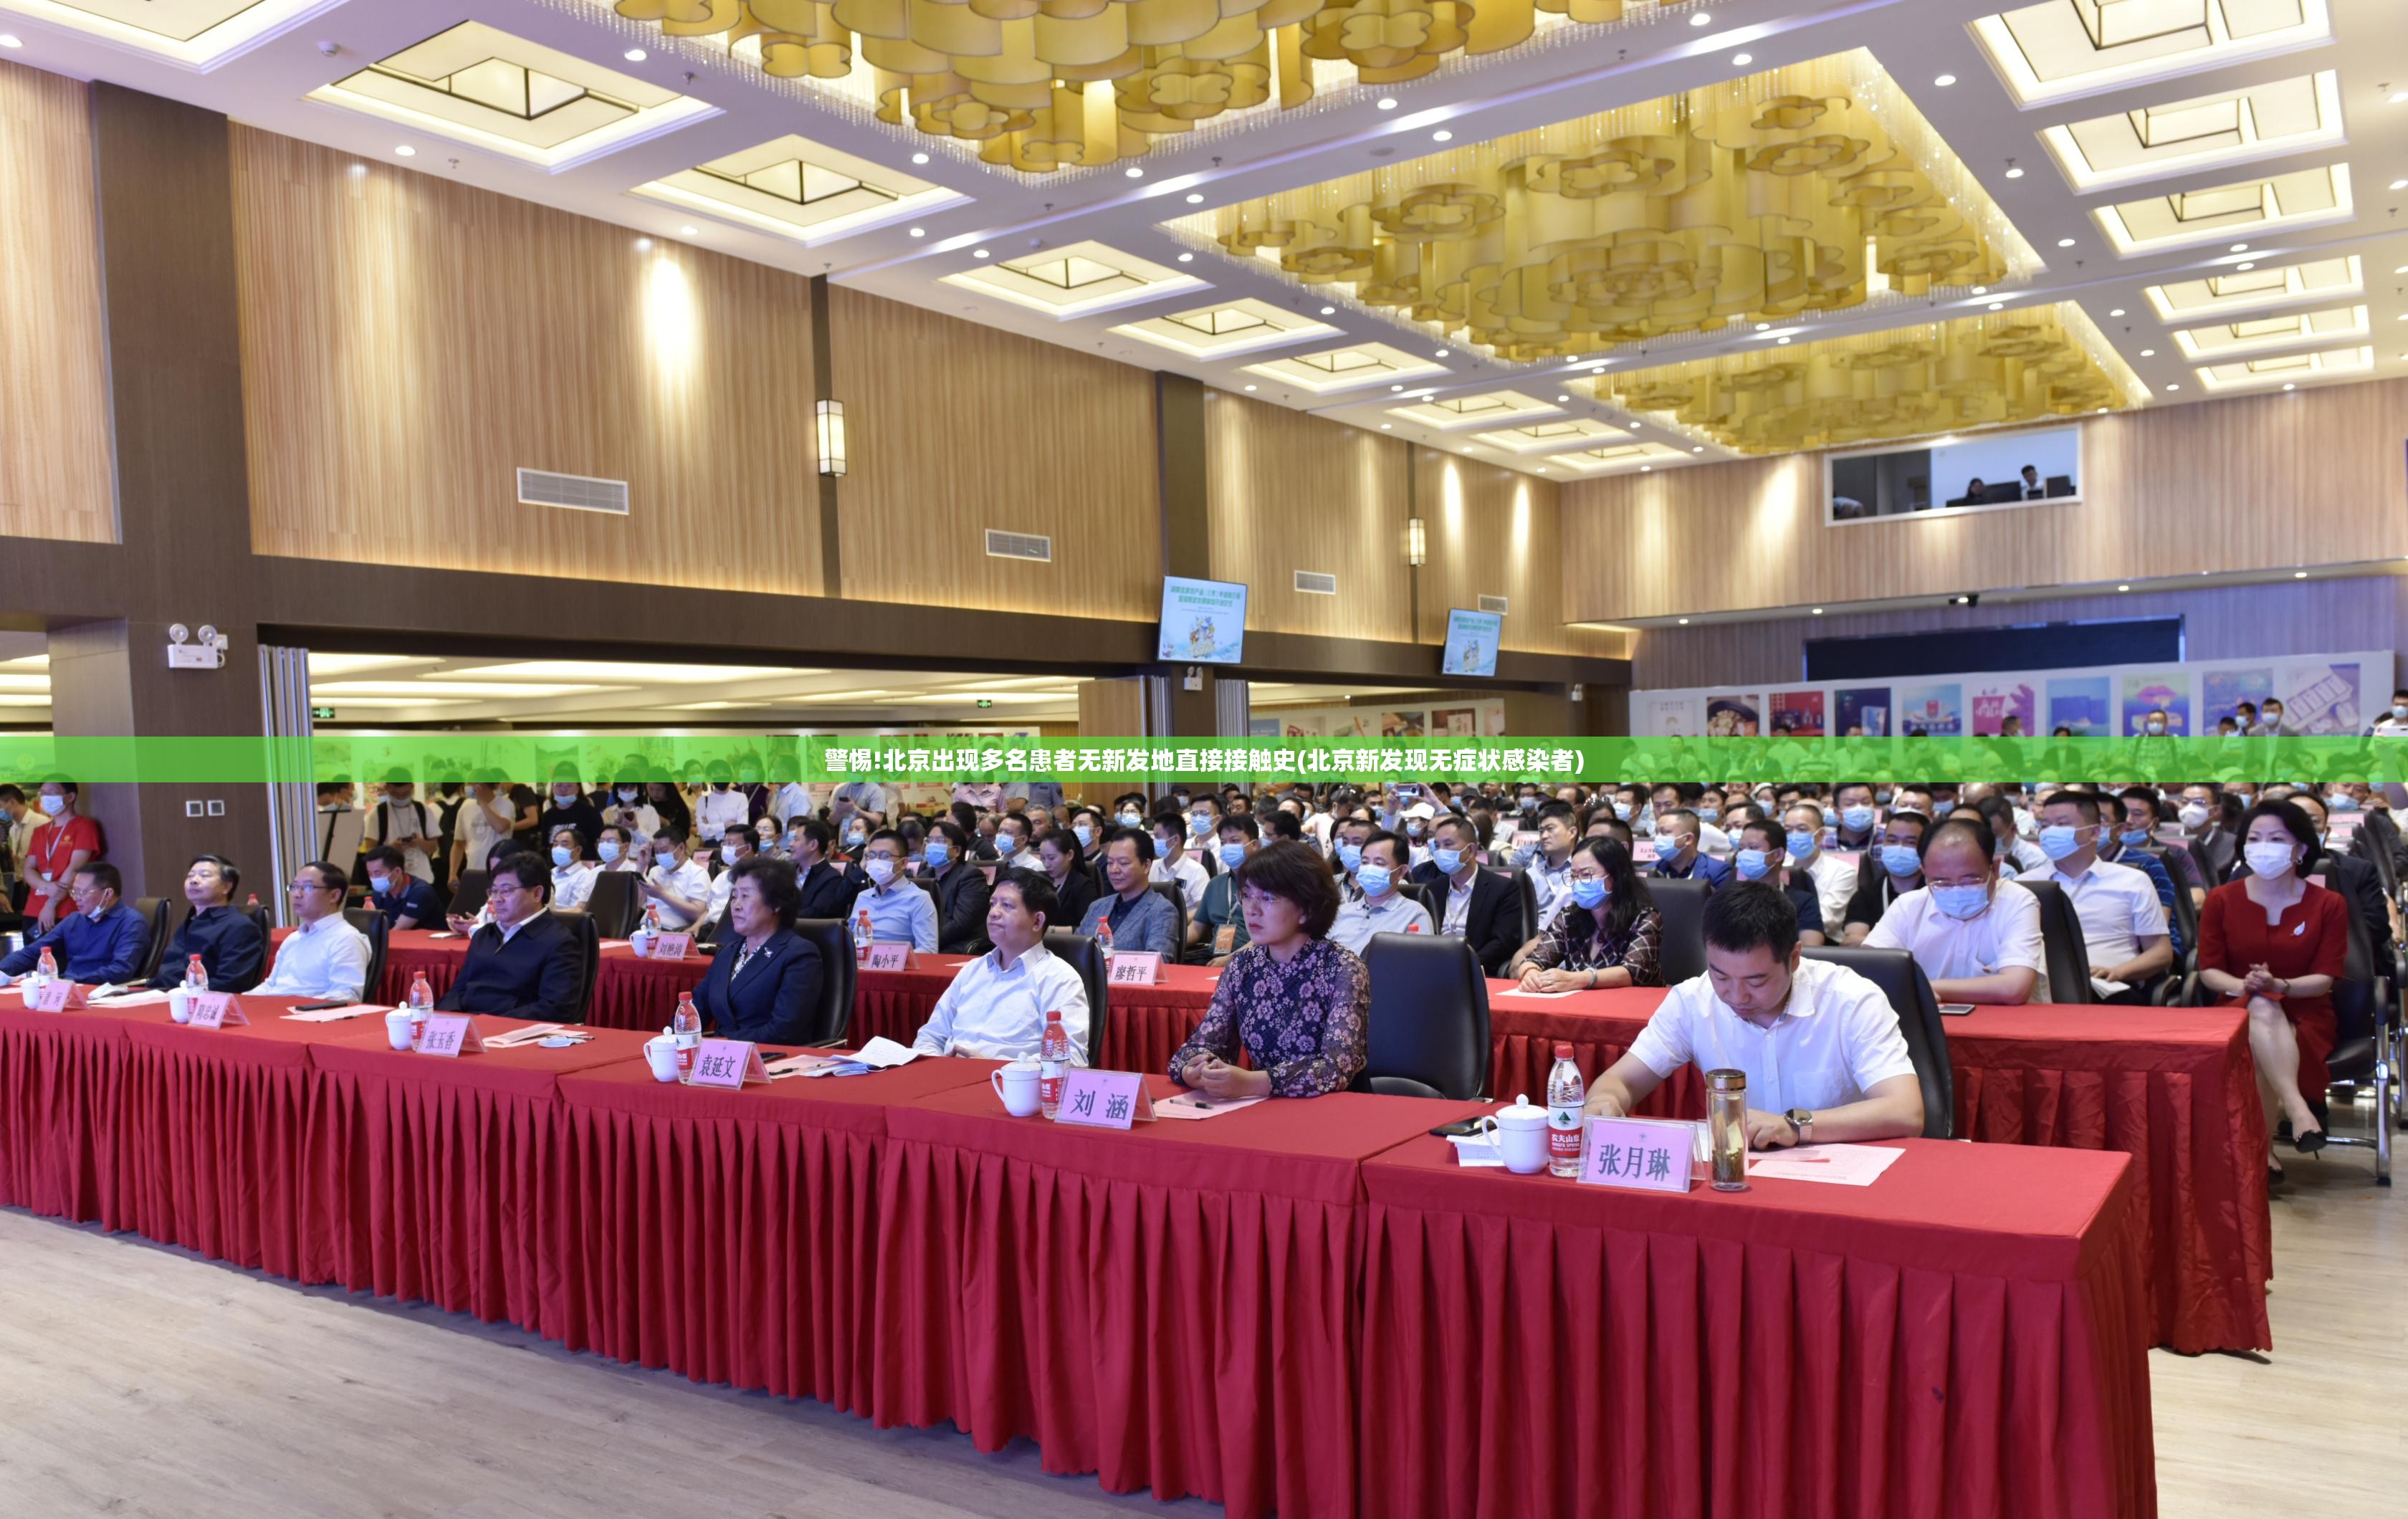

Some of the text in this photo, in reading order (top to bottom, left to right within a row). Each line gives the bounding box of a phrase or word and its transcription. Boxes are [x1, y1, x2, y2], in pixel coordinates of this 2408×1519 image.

[1114, 965, 1147, 982] 廖哲平
[698, 1055, 736, 1078] 袁延文
[1552, 1134, 1580, 1143] 农夫山泉
[1597, 1144, 1671, 1182] 张月琳
